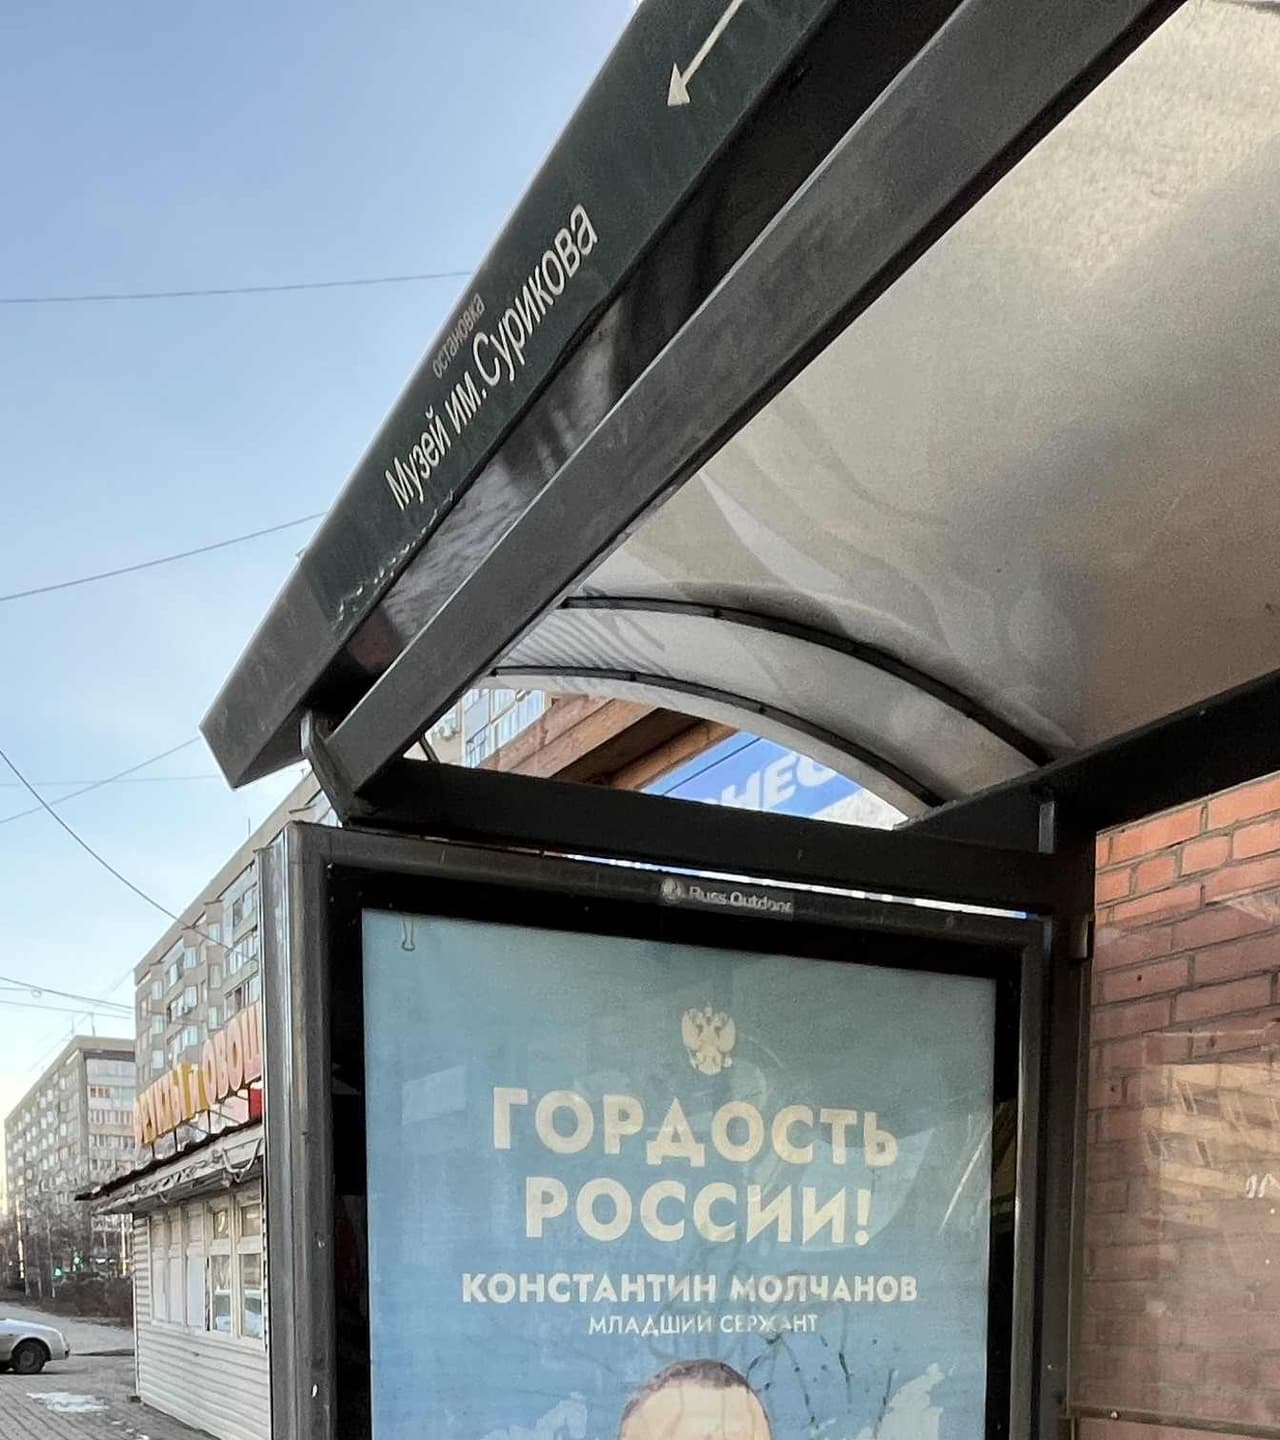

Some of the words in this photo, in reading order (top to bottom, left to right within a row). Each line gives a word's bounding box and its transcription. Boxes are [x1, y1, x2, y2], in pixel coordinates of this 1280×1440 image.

[431, 292, 486, 380] остановка
[384, 405, 452, 512] Музей
[688, 885, 728, 906] Russ
[491, 1086, 898, 1168] ГОРДОСТЬ
[525, 1175, 872, 1247] РОССИИ!
[461, 1271, 718, 1305] КОНСТАНТИН
[729, 1273, 918, 1304] МОЛЧАНОВ
